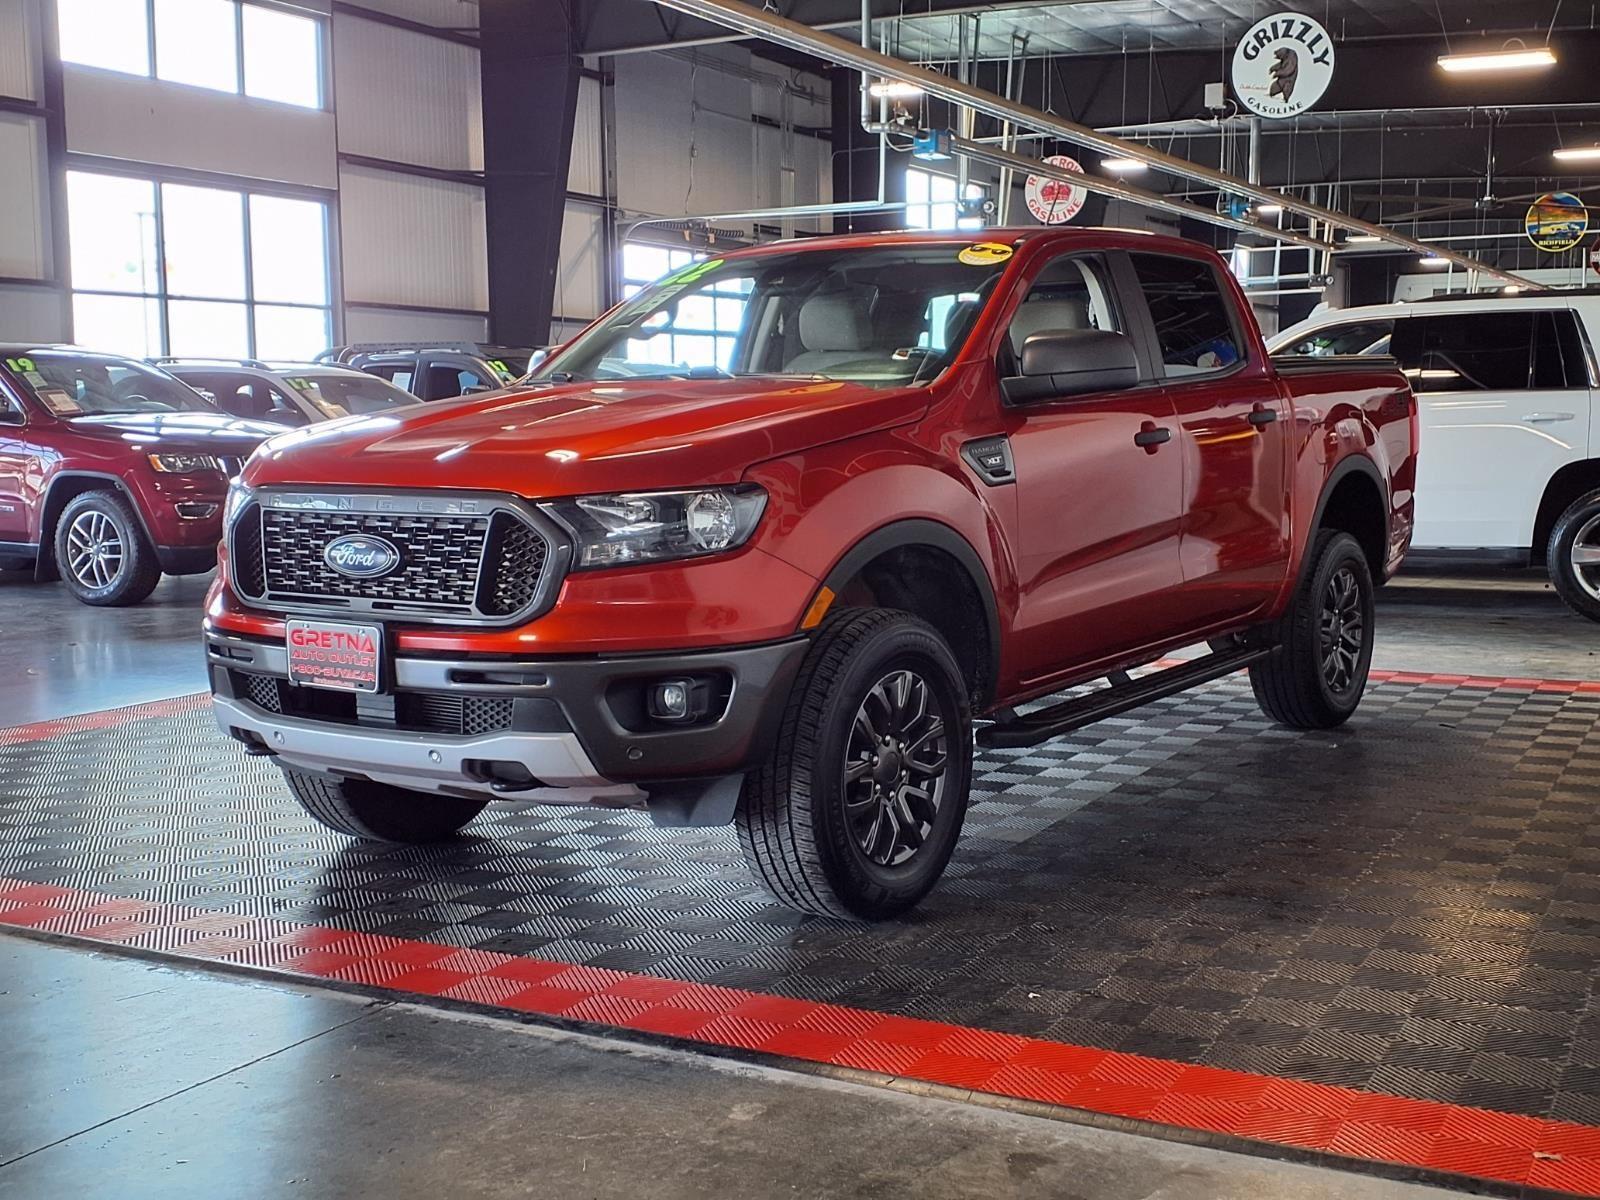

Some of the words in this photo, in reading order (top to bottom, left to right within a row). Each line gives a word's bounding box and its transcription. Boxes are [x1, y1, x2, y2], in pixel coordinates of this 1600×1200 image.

[1243, 19, 1330, 66] GRIZZLY
[1247, 97, 1303, 114] GASOLINE
[1028, 199, 1081, 222] GASOLINE
[6, 358, 34, 372] 19
[987, 456, 1002, 465] XLT
[269, 494, 479, 514] RANGER
[331, 542, 376, 566] Ford
[291, 629, 375, 652] GRETNA
[291, 649, 325, 662] AUTO
[329, 652, 376, 667] OUTLET
